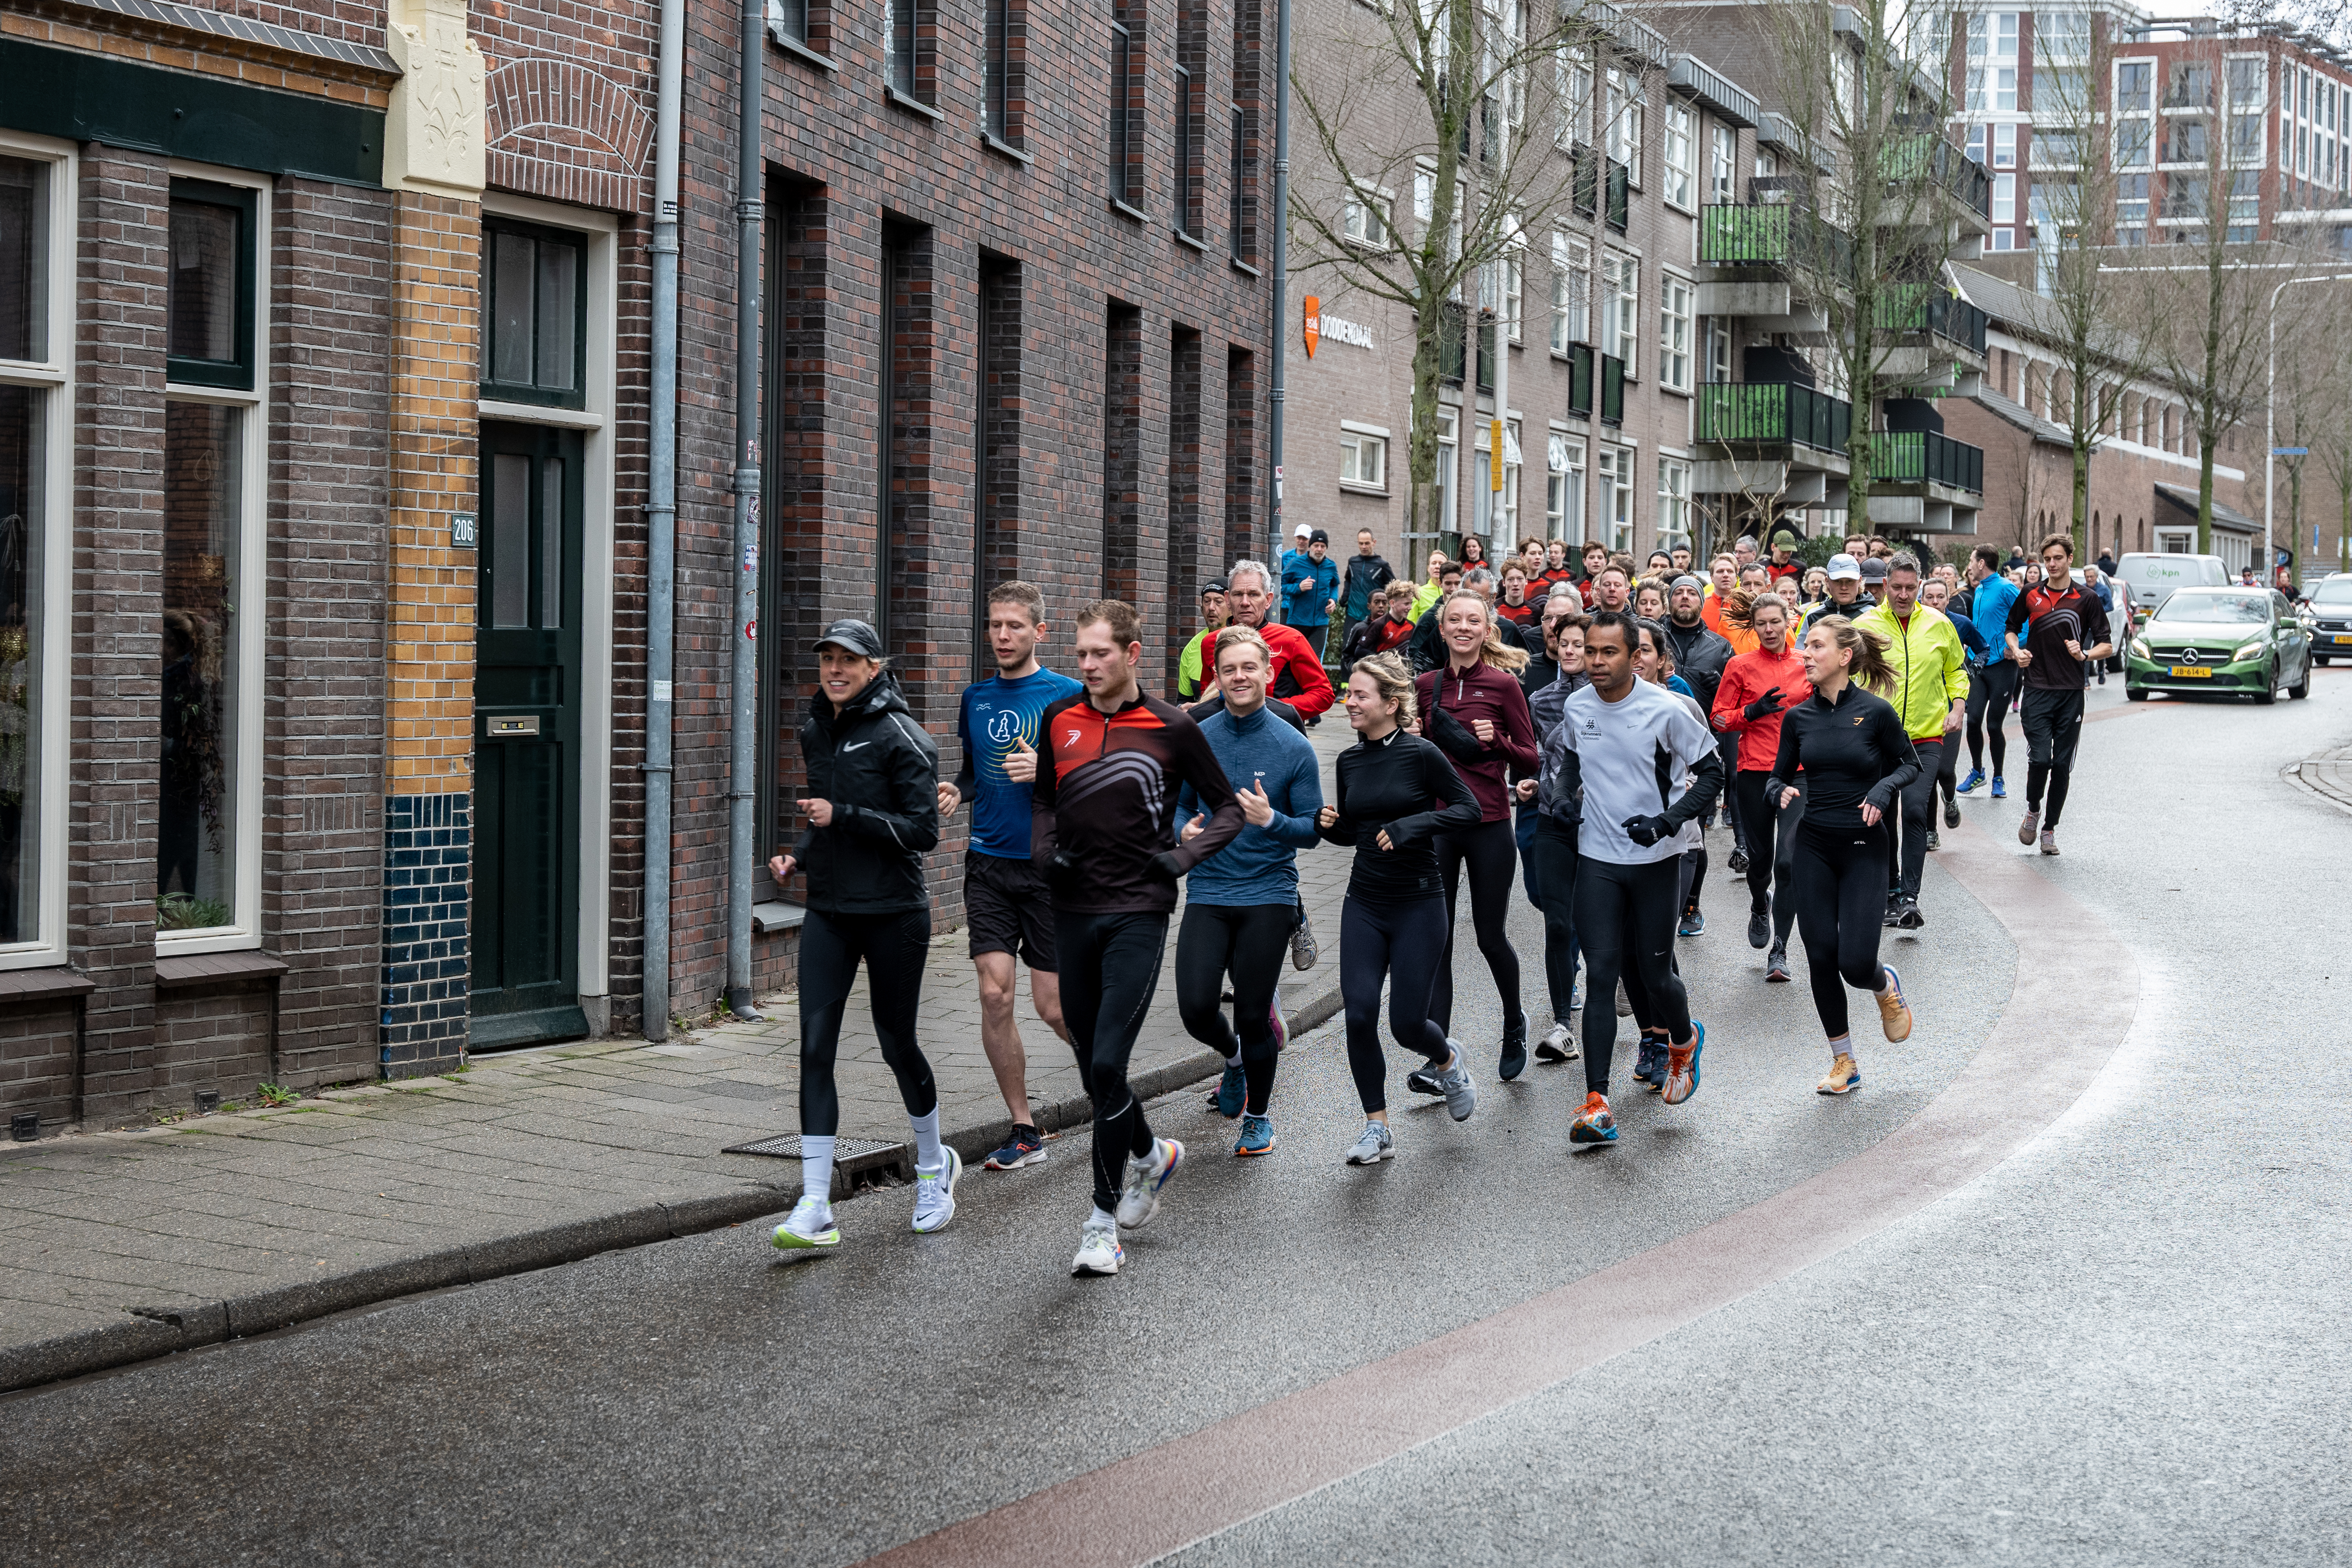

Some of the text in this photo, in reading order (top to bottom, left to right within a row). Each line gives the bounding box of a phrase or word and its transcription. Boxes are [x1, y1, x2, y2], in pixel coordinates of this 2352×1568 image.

[1321, 314, 1374, 349] DODDENDAAL
[455, 519, 473, 542] 206
[2162, 569, 2179, 577] kpn
